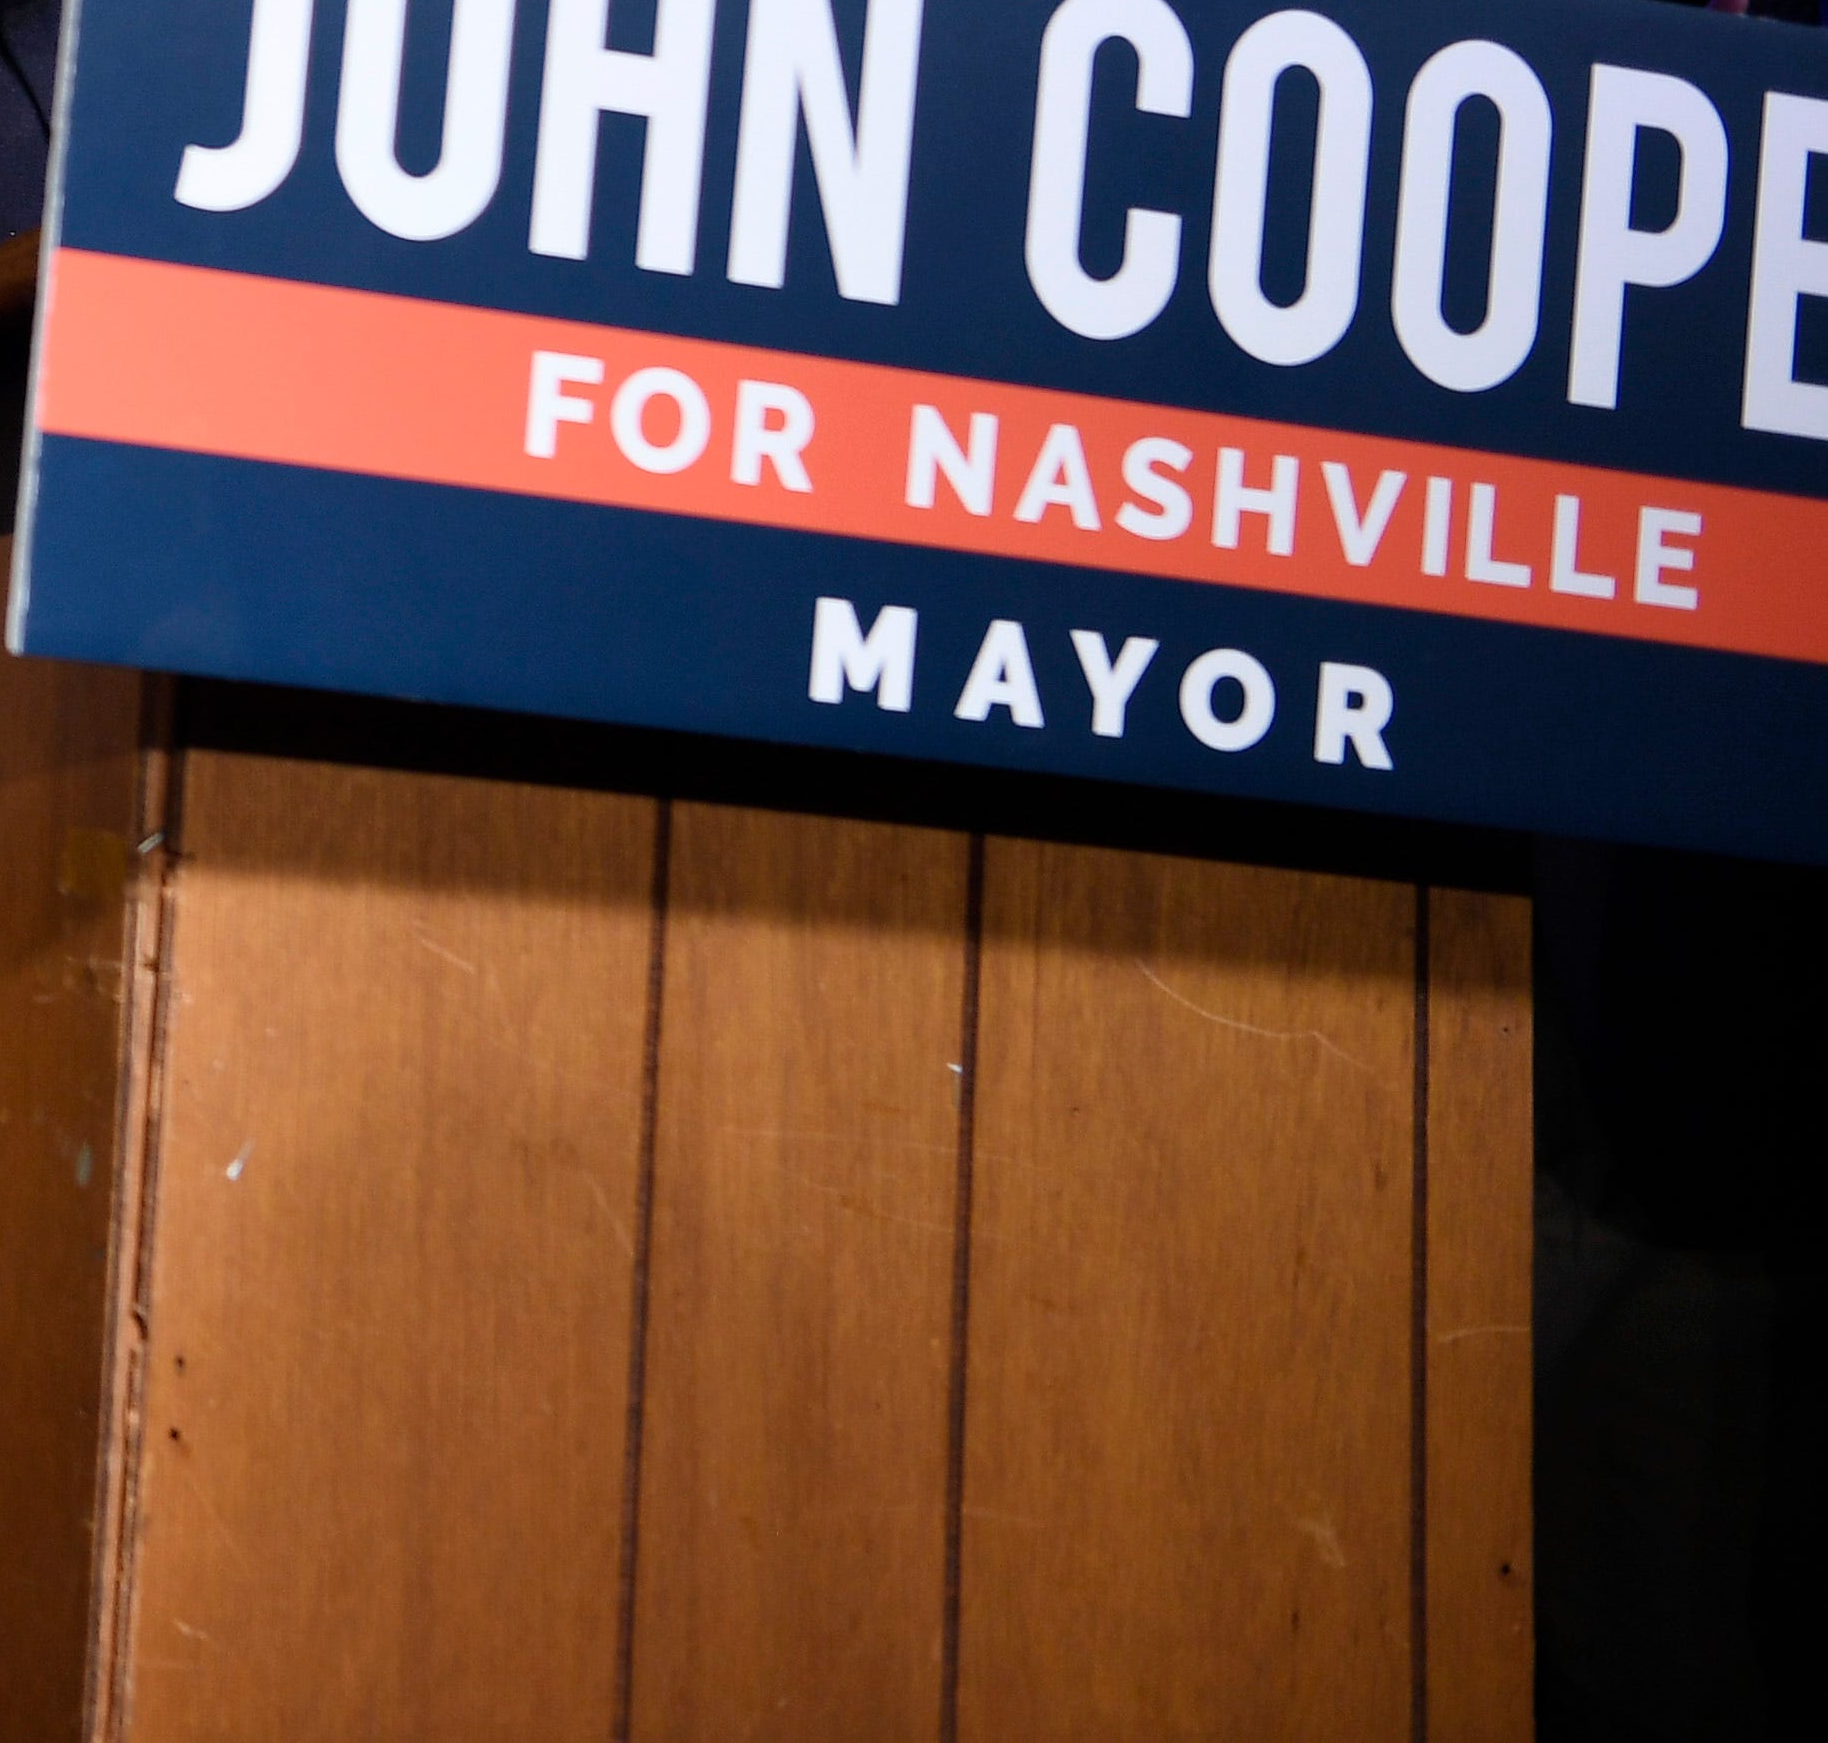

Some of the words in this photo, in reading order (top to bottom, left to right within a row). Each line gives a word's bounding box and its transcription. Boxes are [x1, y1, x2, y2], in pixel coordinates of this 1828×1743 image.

[523, 349, 816, 494] FOR
[904, 403, 1703, 612] NASHVILLE
[808, 597, 1394, 770] MAYOR
